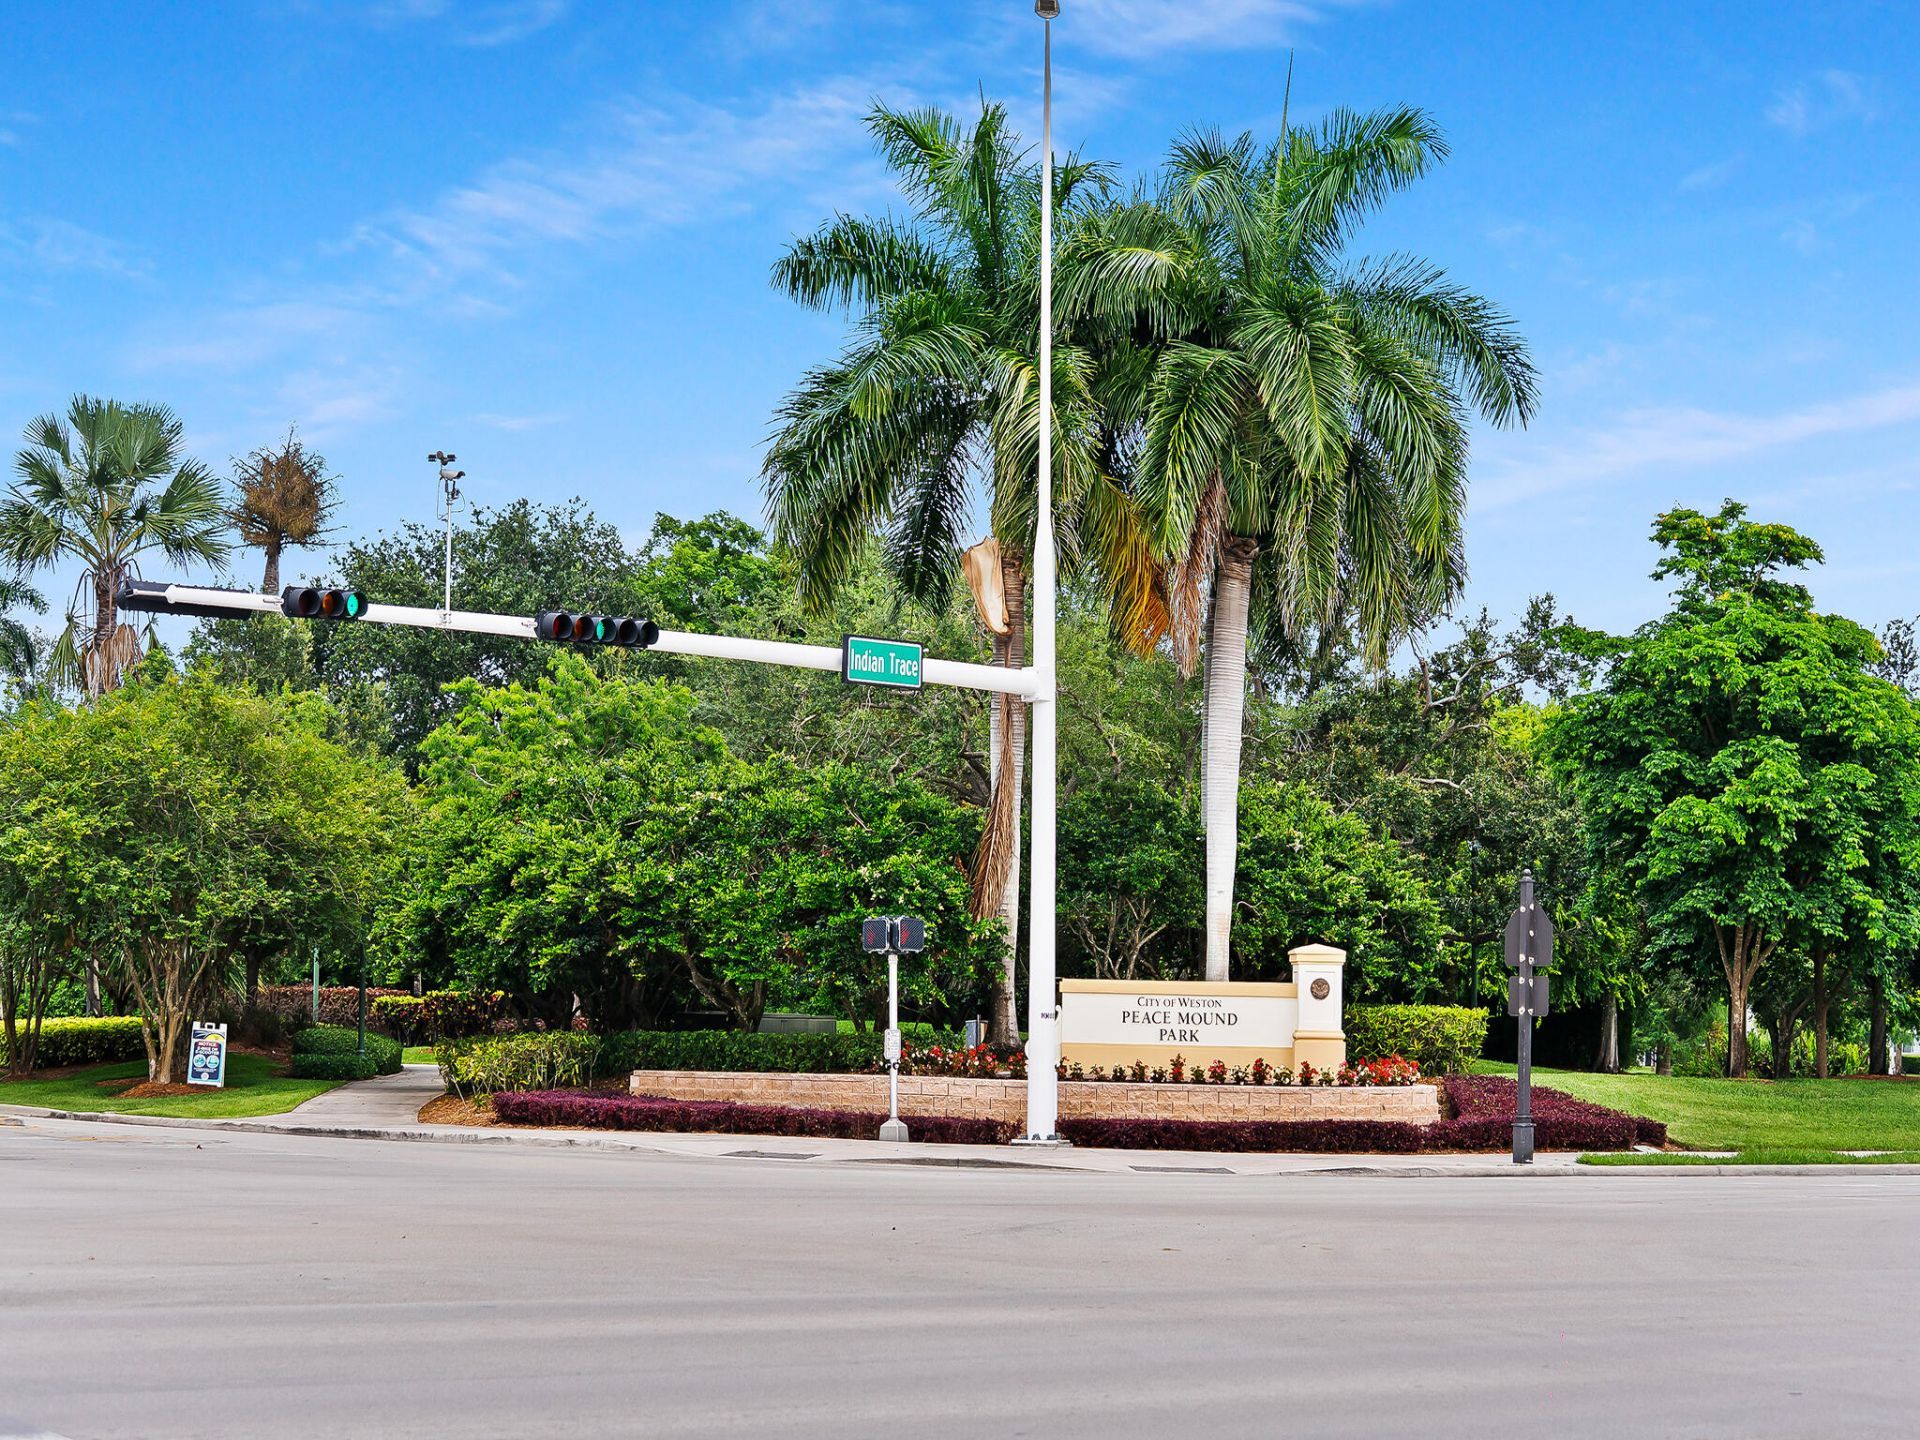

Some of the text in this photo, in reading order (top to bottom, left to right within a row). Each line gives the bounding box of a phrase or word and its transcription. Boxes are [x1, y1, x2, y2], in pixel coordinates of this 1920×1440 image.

[850, 648, 919, 677] Indian Trace
[1121, 1010, 1238, 1026] PEACE MOUND
[1159, 1028, 1199, 1042] PARK
